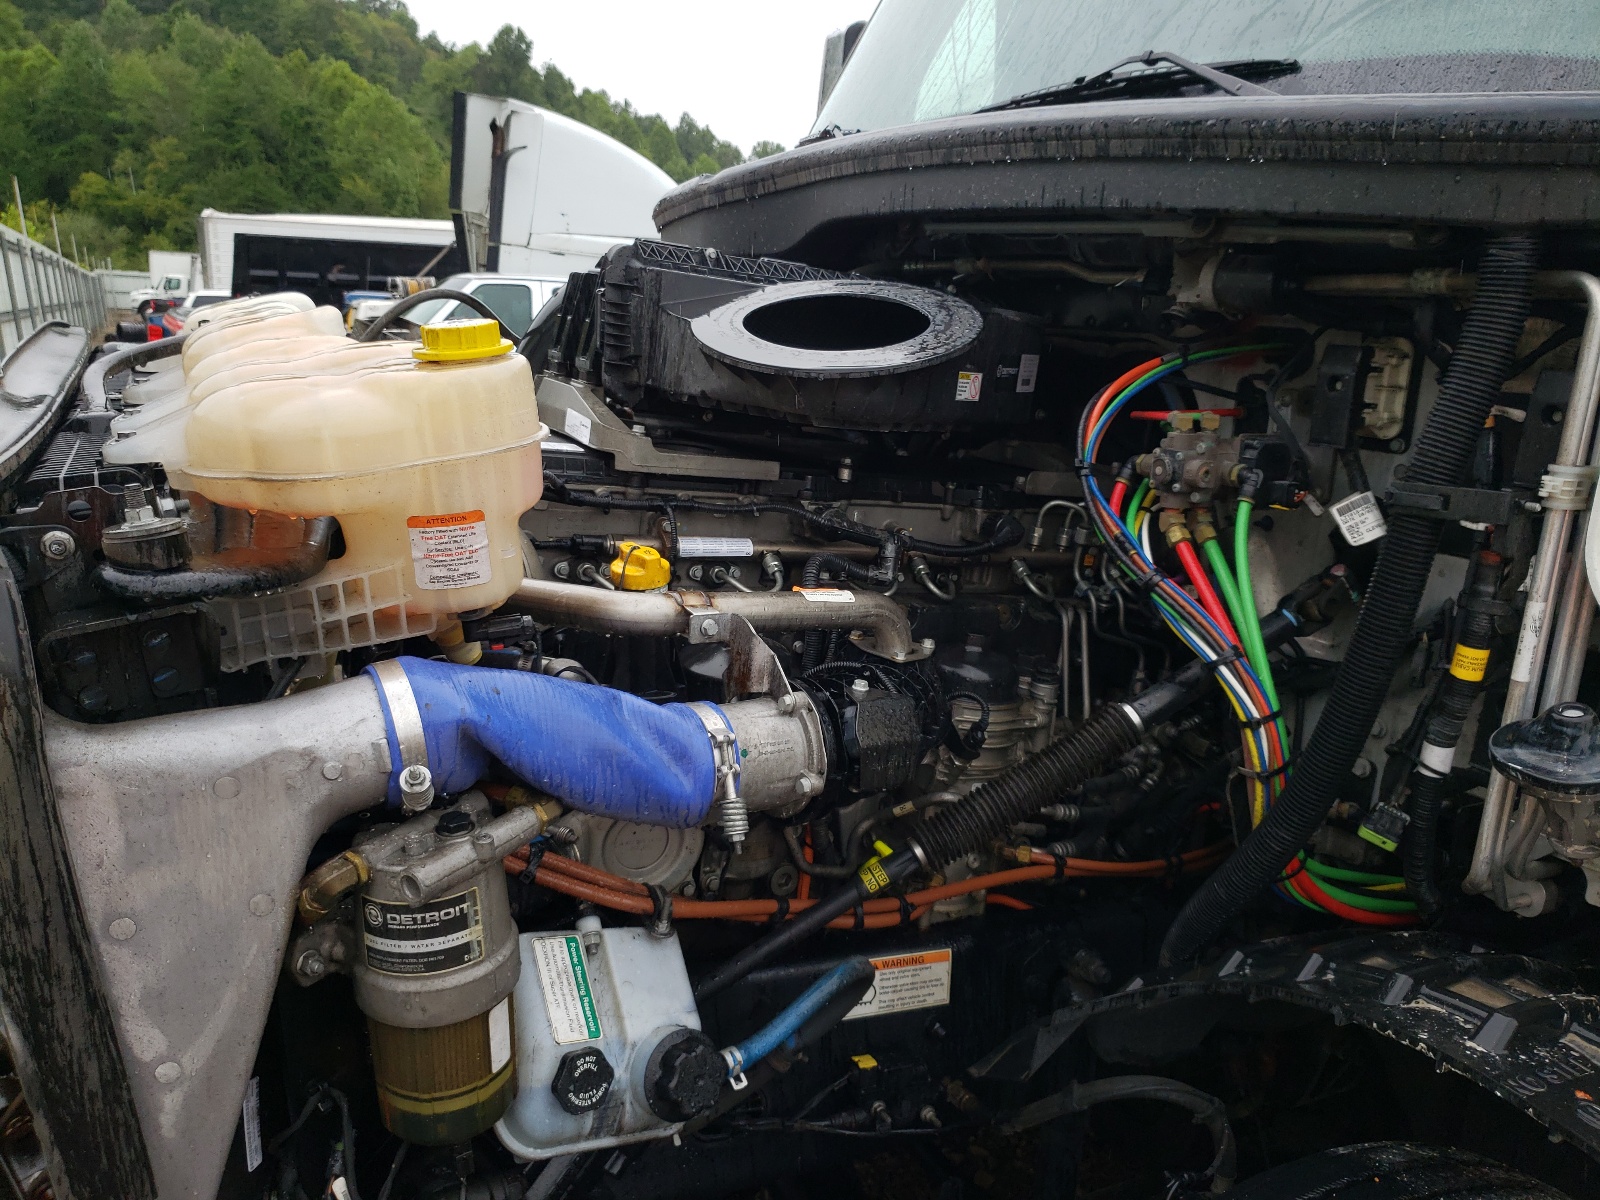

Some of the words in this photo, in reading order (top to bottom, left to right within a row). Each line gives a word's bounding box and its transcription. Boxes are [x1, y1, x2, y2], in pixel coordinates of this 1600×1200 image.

[872, 865, 887, 883] STEP
[866, 878, 876, 890] NO
[387, 903, 471, 925] DETROIT
[438, 931, 474, 947] SEPARATO
[568, 942, 580, 965] Power
[881, 956, 925, 968] WARNING
[559, 956, 572, 988] appropriate
[573, 965, 588, 996] Steering
[549, 981, 558, 998] Super
[582, 996, 597, 1033] Reservoir
[567, 1018, 575, 1033] Fluid
[576, 1057, 585, 1066] DO
[574, 1063, 598, 1077] OVERFILL
[568, 1092, 592, 1106] STEERING
[579, 1089, 597, 1099] FLUID
[590, 1083, 608, 1103] POWER
